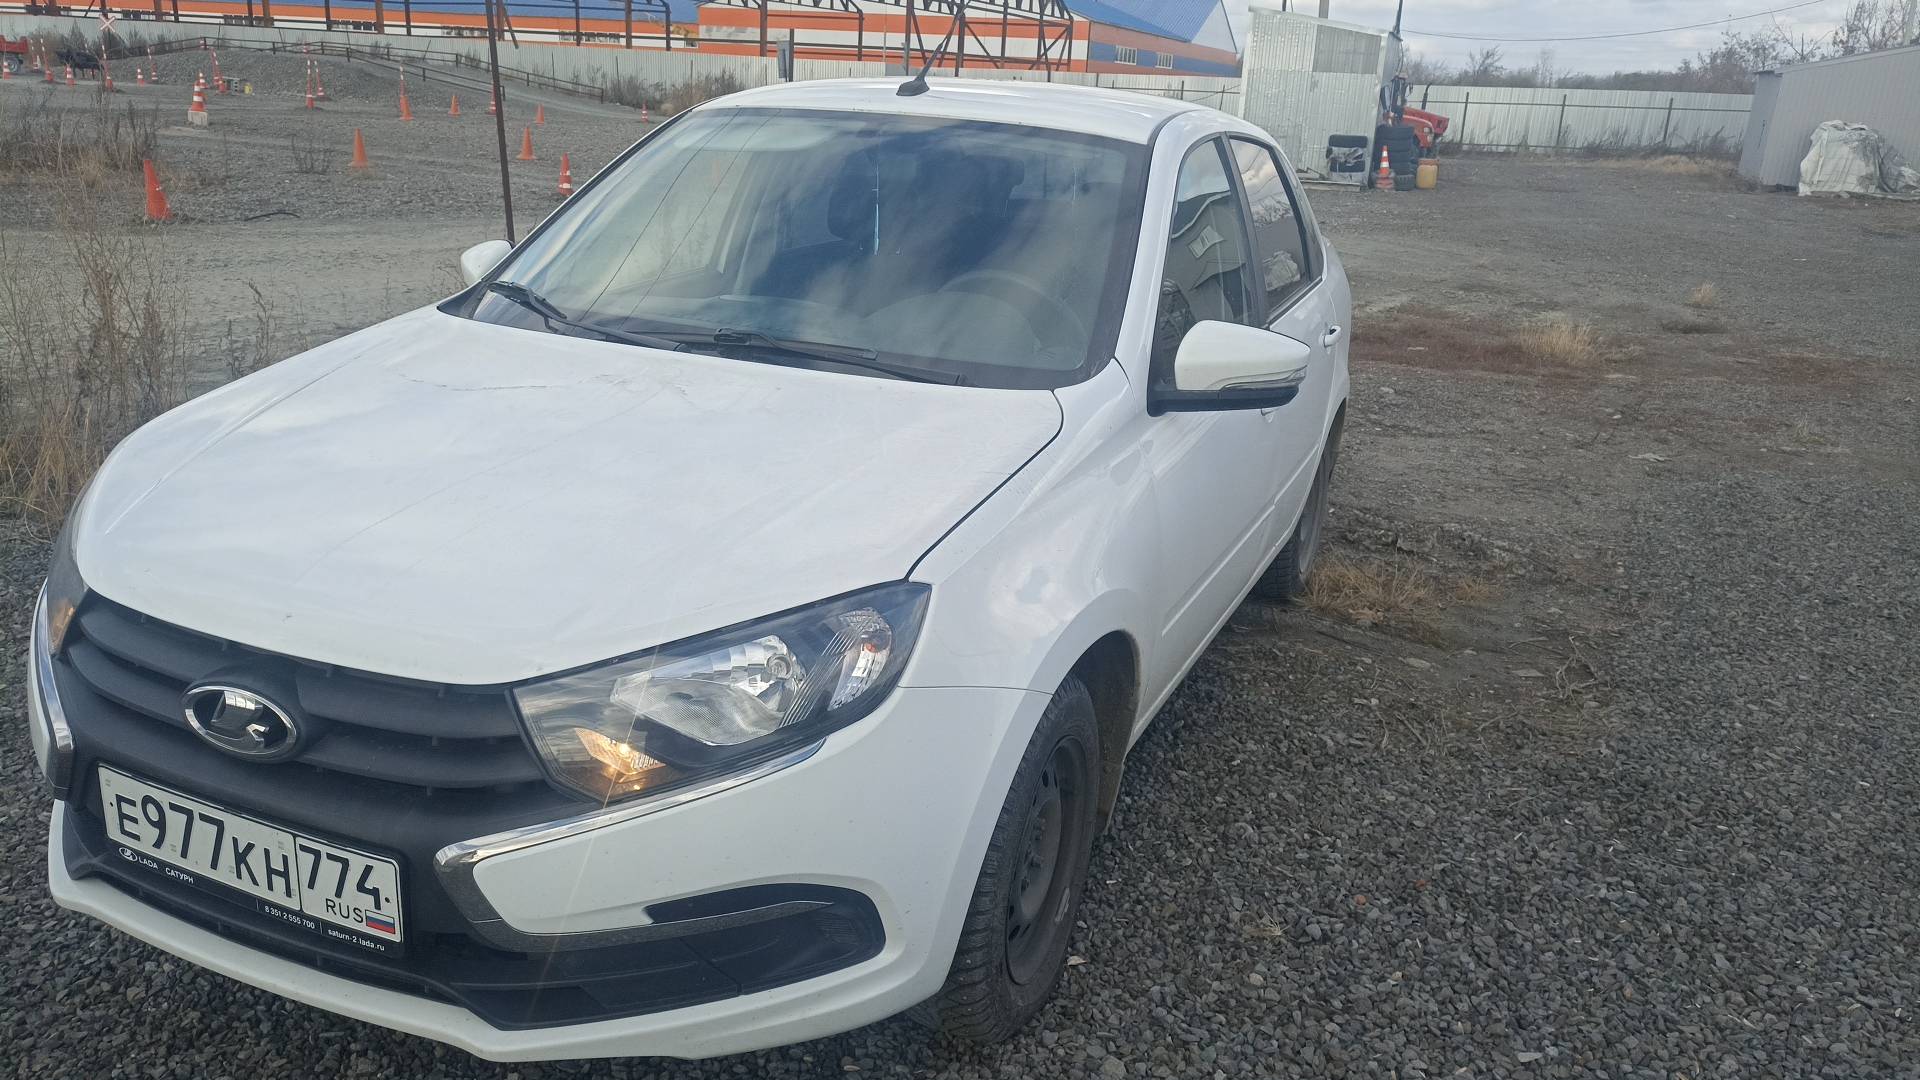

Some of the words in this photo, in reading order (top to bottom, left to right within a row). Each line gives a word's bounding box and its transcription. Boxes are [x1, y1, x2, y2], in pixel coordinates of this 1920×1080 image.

[139, 856, 158, 869] LADA
[165, 867, 194, 884] САТУРН
[298, 843, 382, 911] 774
[264, 905, 270, 913] 8
[270, 907, 281, 917] 351
[283, 912, 288, 920] 2
[288, 913, 301, 924] 555
[302, 919, 316, 930] 700
[325, 898, 364, 924] RUS
